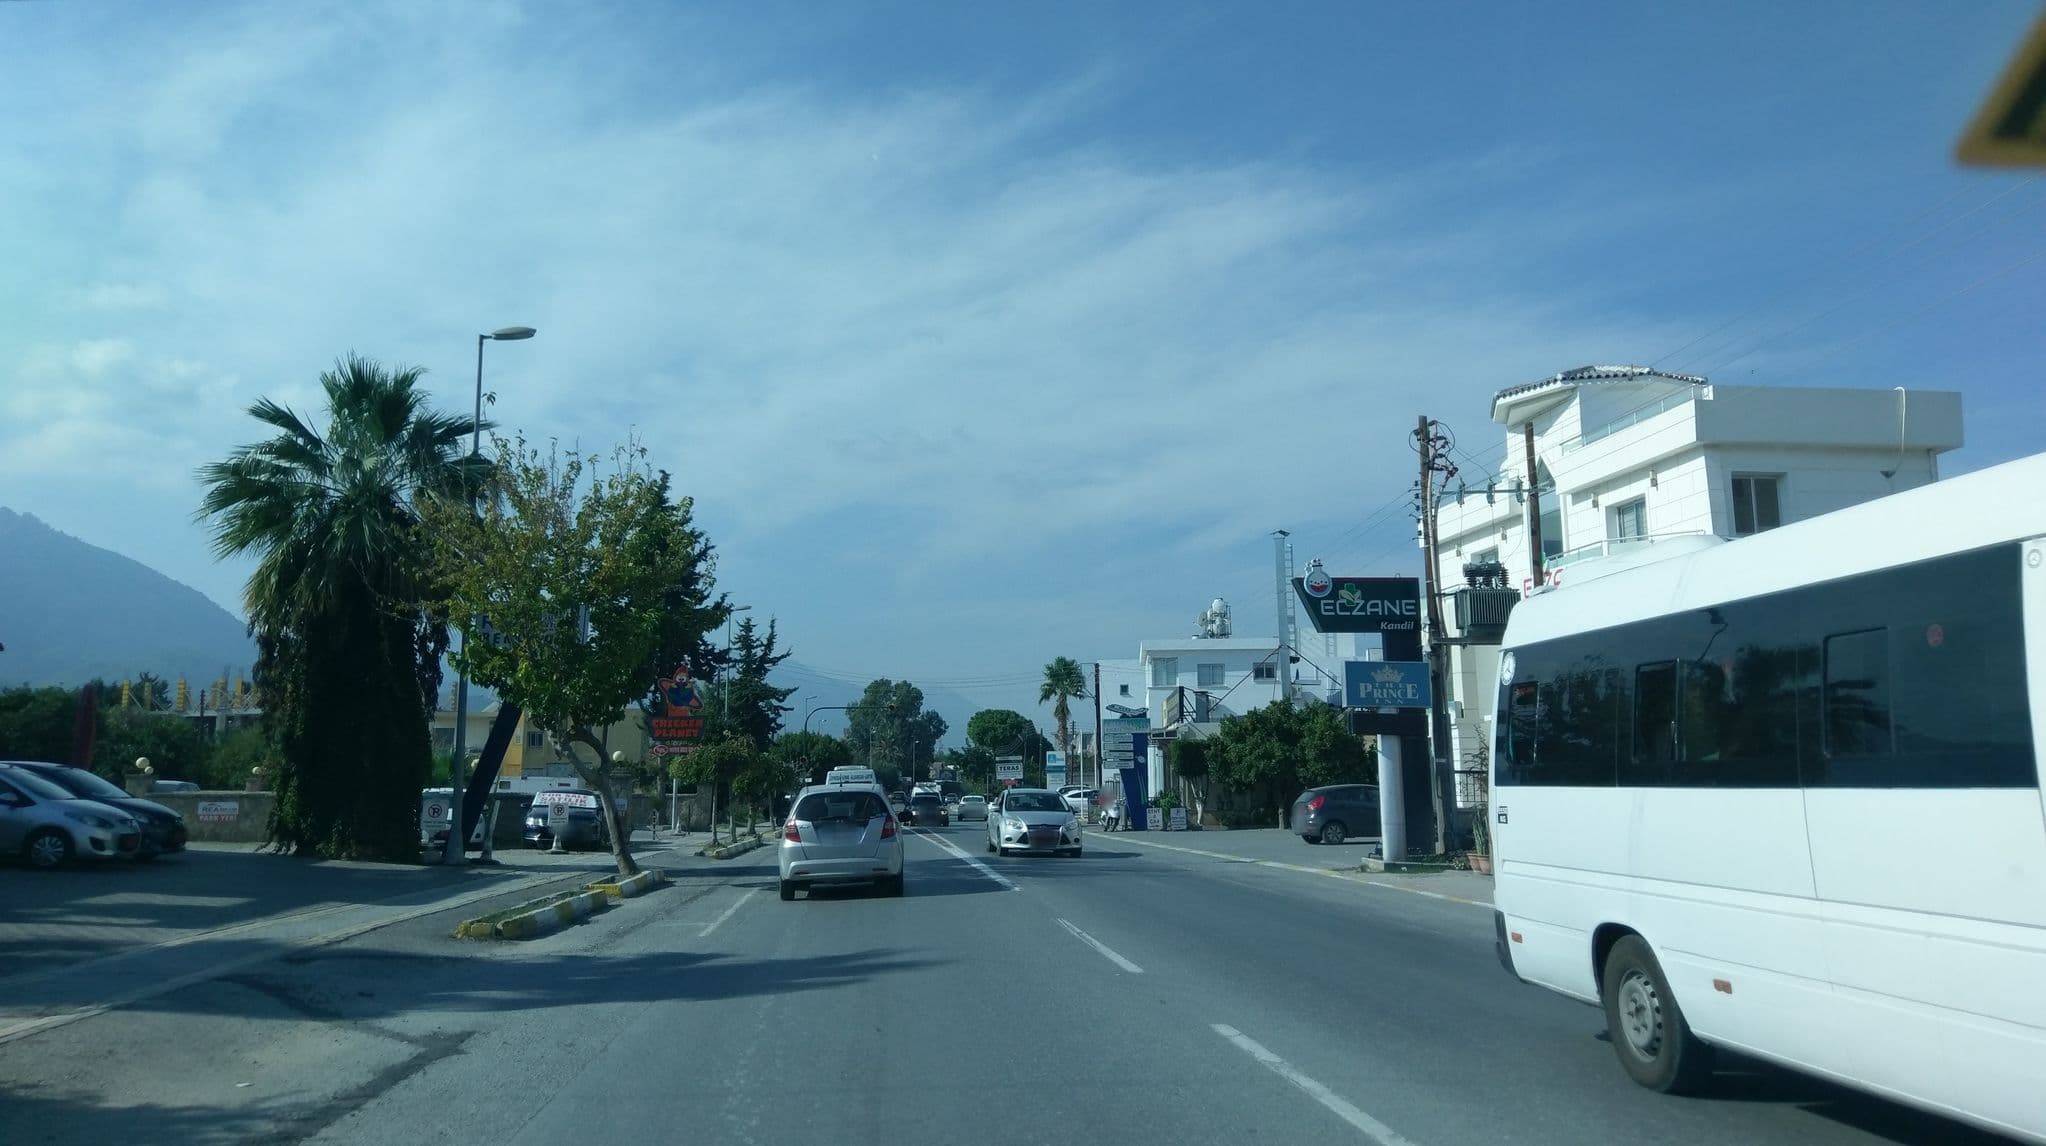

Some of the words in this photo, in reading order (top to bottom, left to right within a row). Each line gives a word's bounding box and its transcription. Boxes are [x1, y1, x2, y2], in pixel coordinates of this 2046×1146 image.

[1320, 599, 1417, 616] ECZANE
[1380, 621, 1414, 630] Kandil
[1359, 682, 1419, 699] PRINCE
[652, 719, 703, 728] CHICKEN
[655, 729, 699, 737] PLANET
